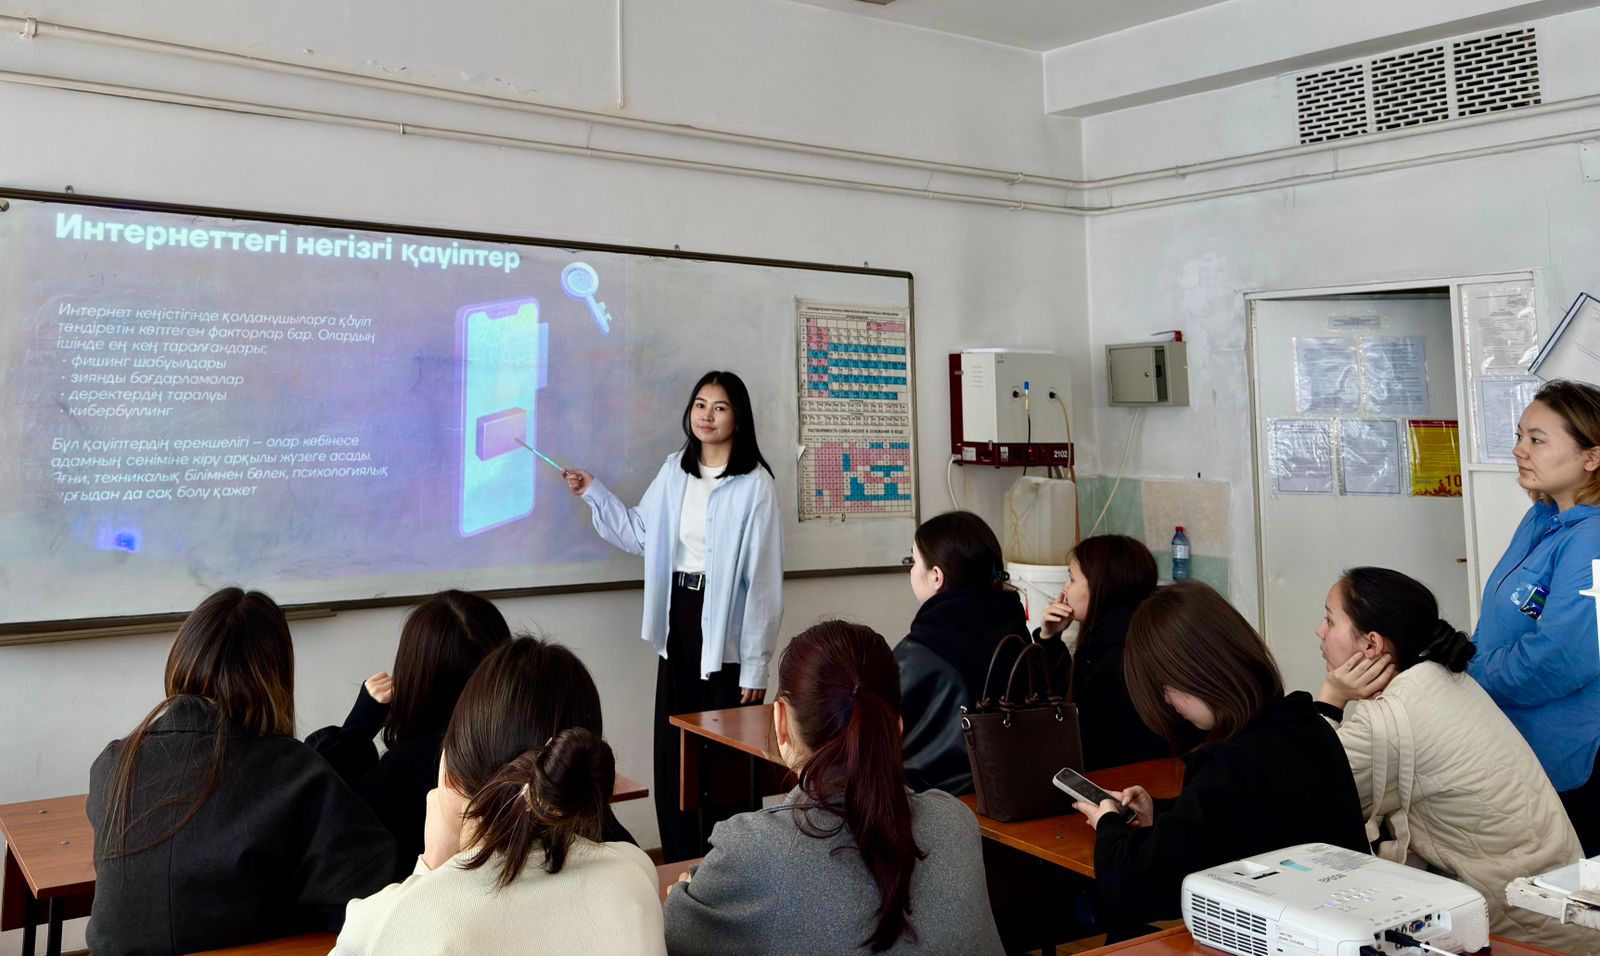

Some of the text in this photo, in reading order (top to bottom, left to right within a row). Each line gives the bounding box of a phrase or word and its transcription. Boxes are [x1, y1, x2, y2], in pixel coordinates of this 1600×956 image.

[55, 212, 521, 273] Интернеттегі негізгі қауіптер
[58, 303, 372, 329] Интернет кеңістігінде қолданушыларға қауіп
[58, 322, 376, 344] төндіретін көптеген факторлар бар. Олардың
[56, 337, 267, 356] ішінде ең кең таралғандары:
[71, 354, 227, 371] фишинг шабуылдары
[70, 372, 244, 387] зиянды бағдарламалар
[68, 388, 227, 403] деректердің таралуы
[69, 404, 173, 419] кибербуллинг
[52, 437, 79, 453] Бұл
[83, 437, 169, 451] қауіптердің
[174, 436, 249, 450] ерекшелігі
[266, 437, 299, 449] олар
[303, 435, 359, 447] көбінесе
[51, 456, 121, 469] адамның
[126, 454, 189, 466] сеніміне
[192, 453, 221, 466] кіру
[224, 454, 277, 467] арқылы
[280, 451, 327, 466] жүзеге
[94, 472, 180, 485] техникалық
[184, 468, 243, 481] білімнен
[247, 467, 289, 480] бөлек,
[292, 465, 388, 479] психологиялық
[60, 485, 258, 504] рғыдан да сақ болу қажет
